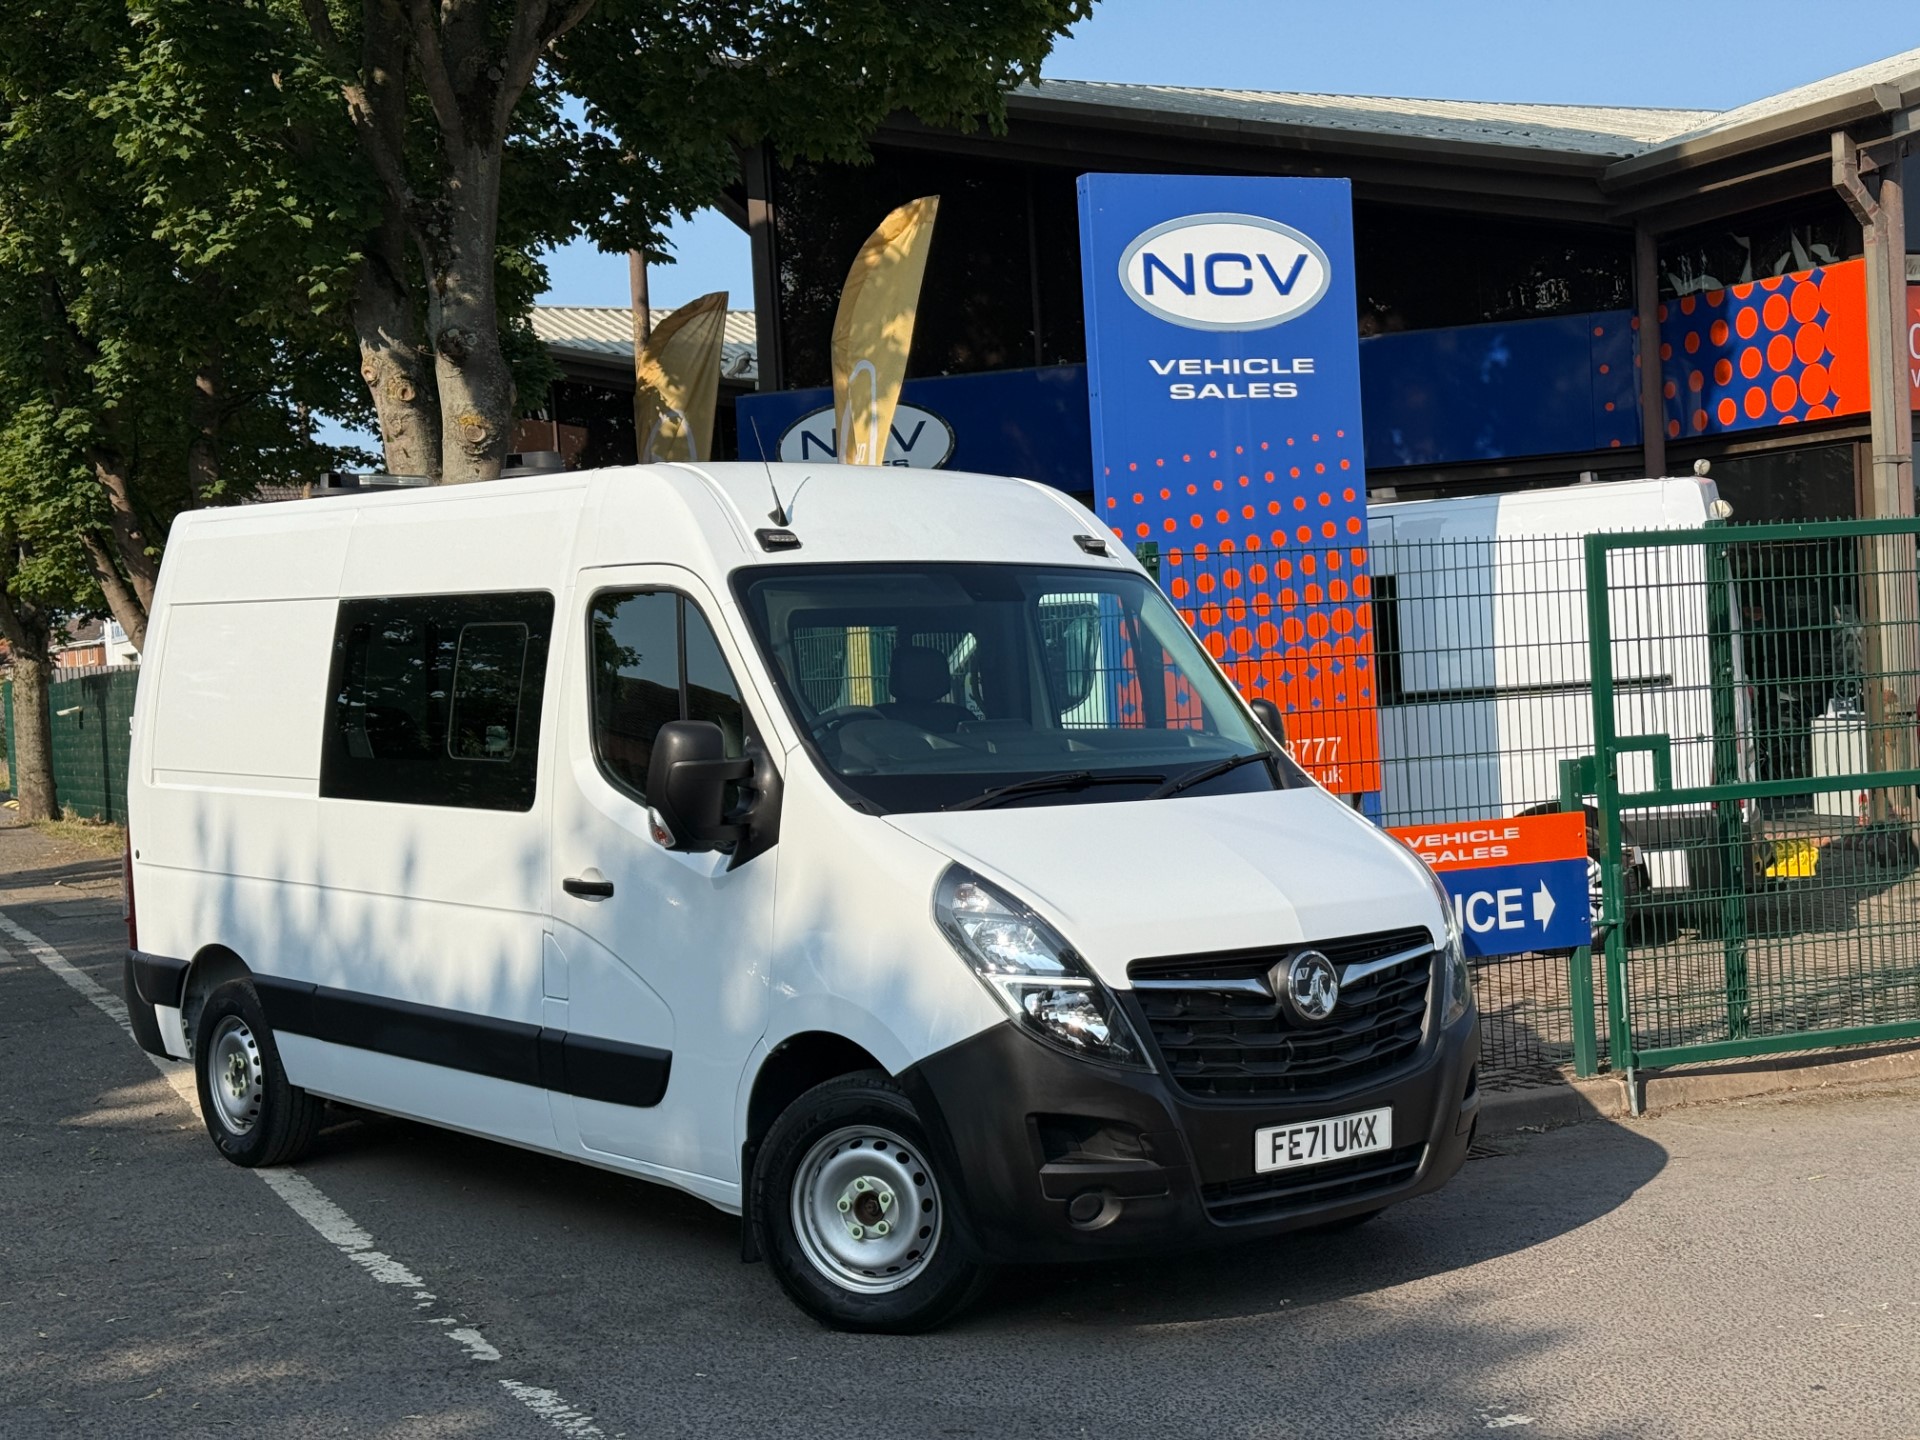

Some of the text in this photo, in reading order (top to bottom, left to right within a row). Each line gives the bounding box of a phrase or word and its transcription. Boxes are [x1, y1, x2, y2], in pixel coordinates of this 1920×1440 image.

[1142, 252, 1308, 296] NCV
[1148, 358, 1315, 375] VEHICLE
[1169, 382, 1298, 400] SALES
[801, 420, 926, 460] NV
[1404, 827, 1520, 848] VEHICLE
[1419, 845, 1509, 864] SALES
[1271, 1115, 1377, 1164] FE71 UKX
